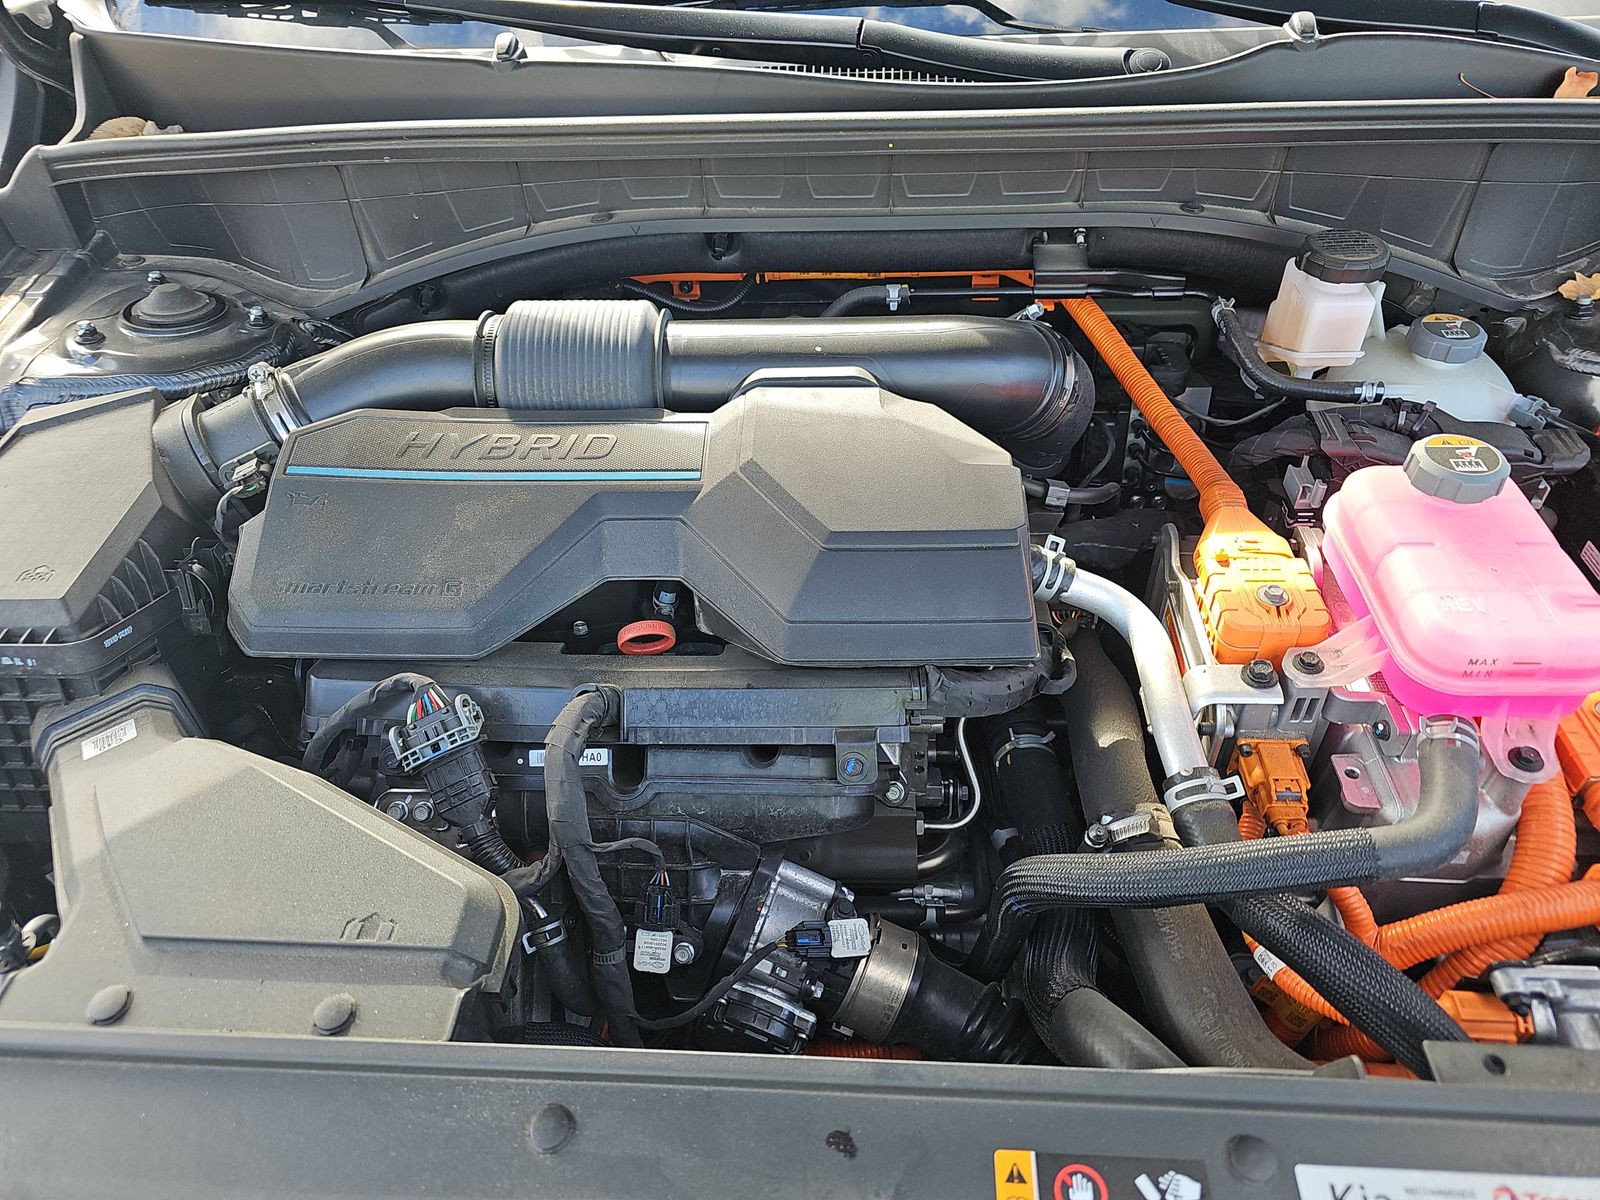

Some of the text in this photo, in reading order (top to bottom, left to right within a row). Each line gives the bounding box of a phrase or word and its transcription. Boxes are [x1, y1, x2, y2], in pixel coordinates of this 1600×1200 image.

[394, 431, 619, 461] HYBRID
[1467, 658, 1499, 667] MAX
[1462, 670, 1494, 678] MIN
